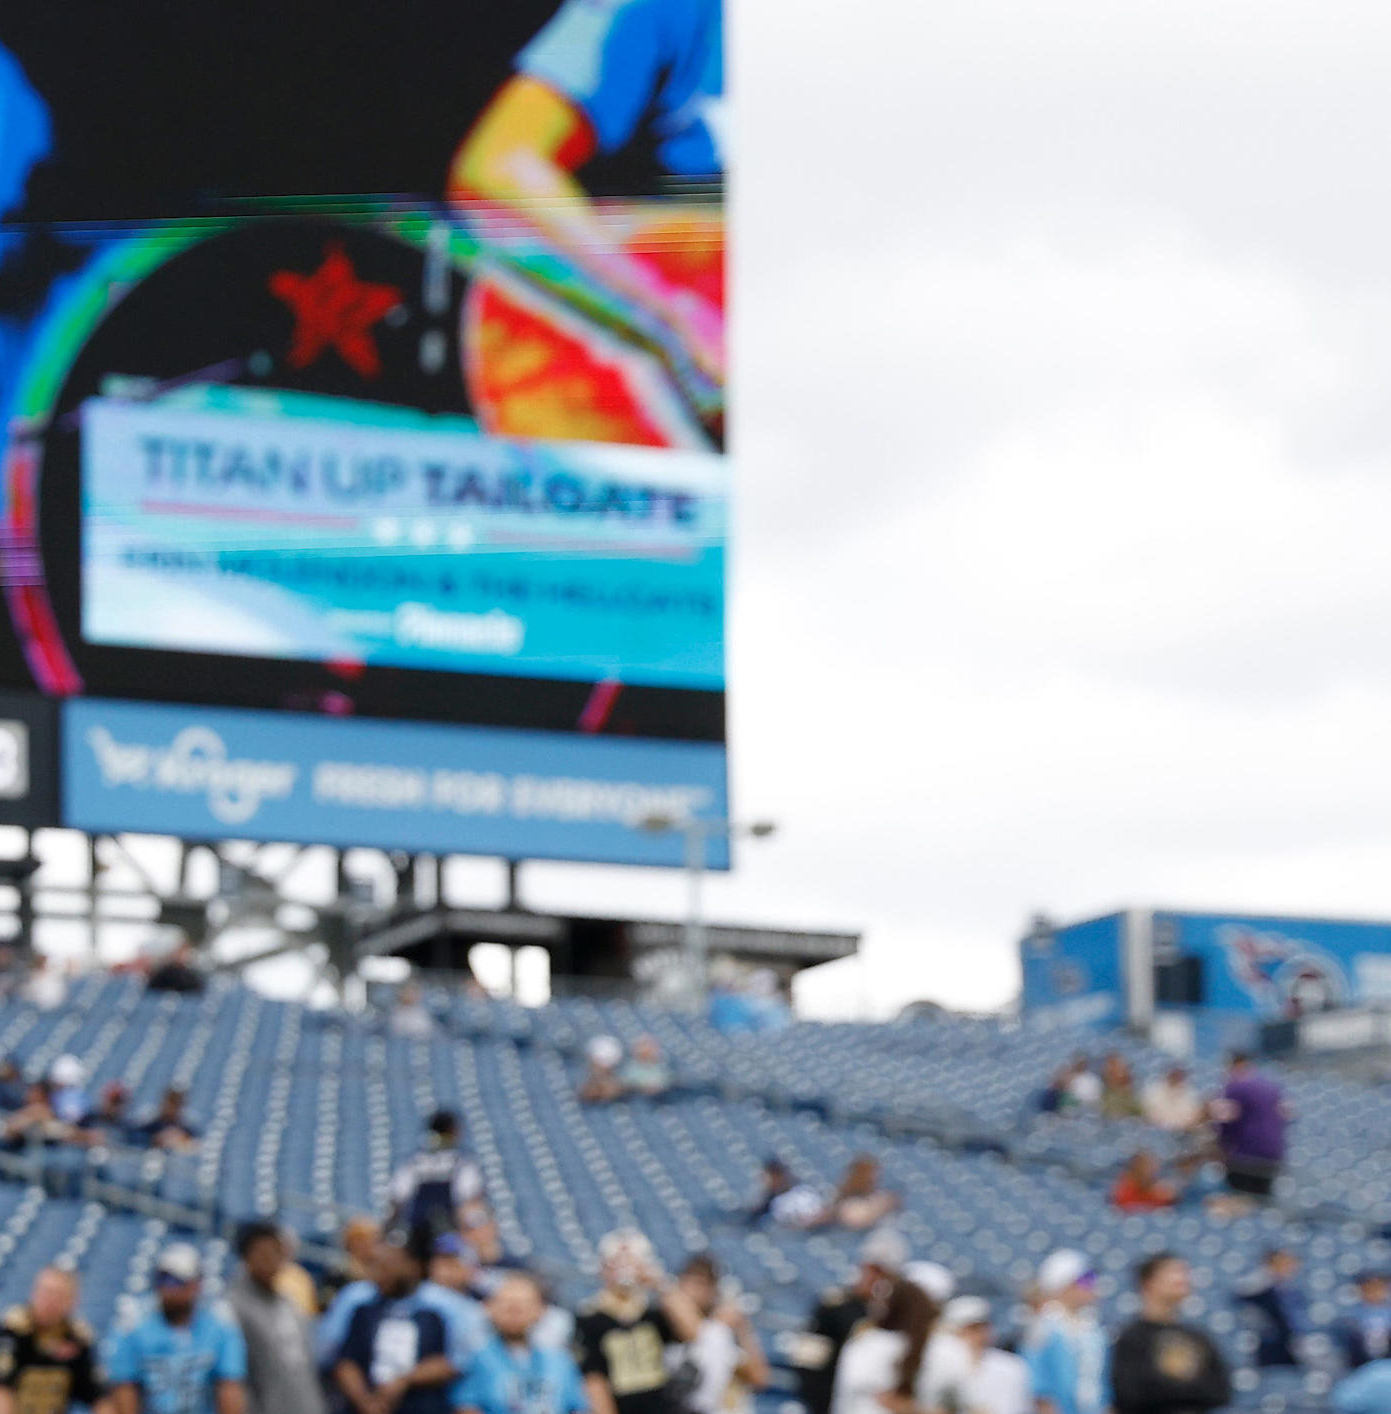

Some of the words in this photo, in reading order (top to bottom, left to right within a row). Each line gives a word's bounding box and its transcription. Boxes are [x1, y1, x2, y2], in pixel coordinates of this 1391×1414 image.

[138, 434, 311, 496] TITAN
[325, 447, 409, 503] UP
[422, 458, 701, 526] TAILGATE
